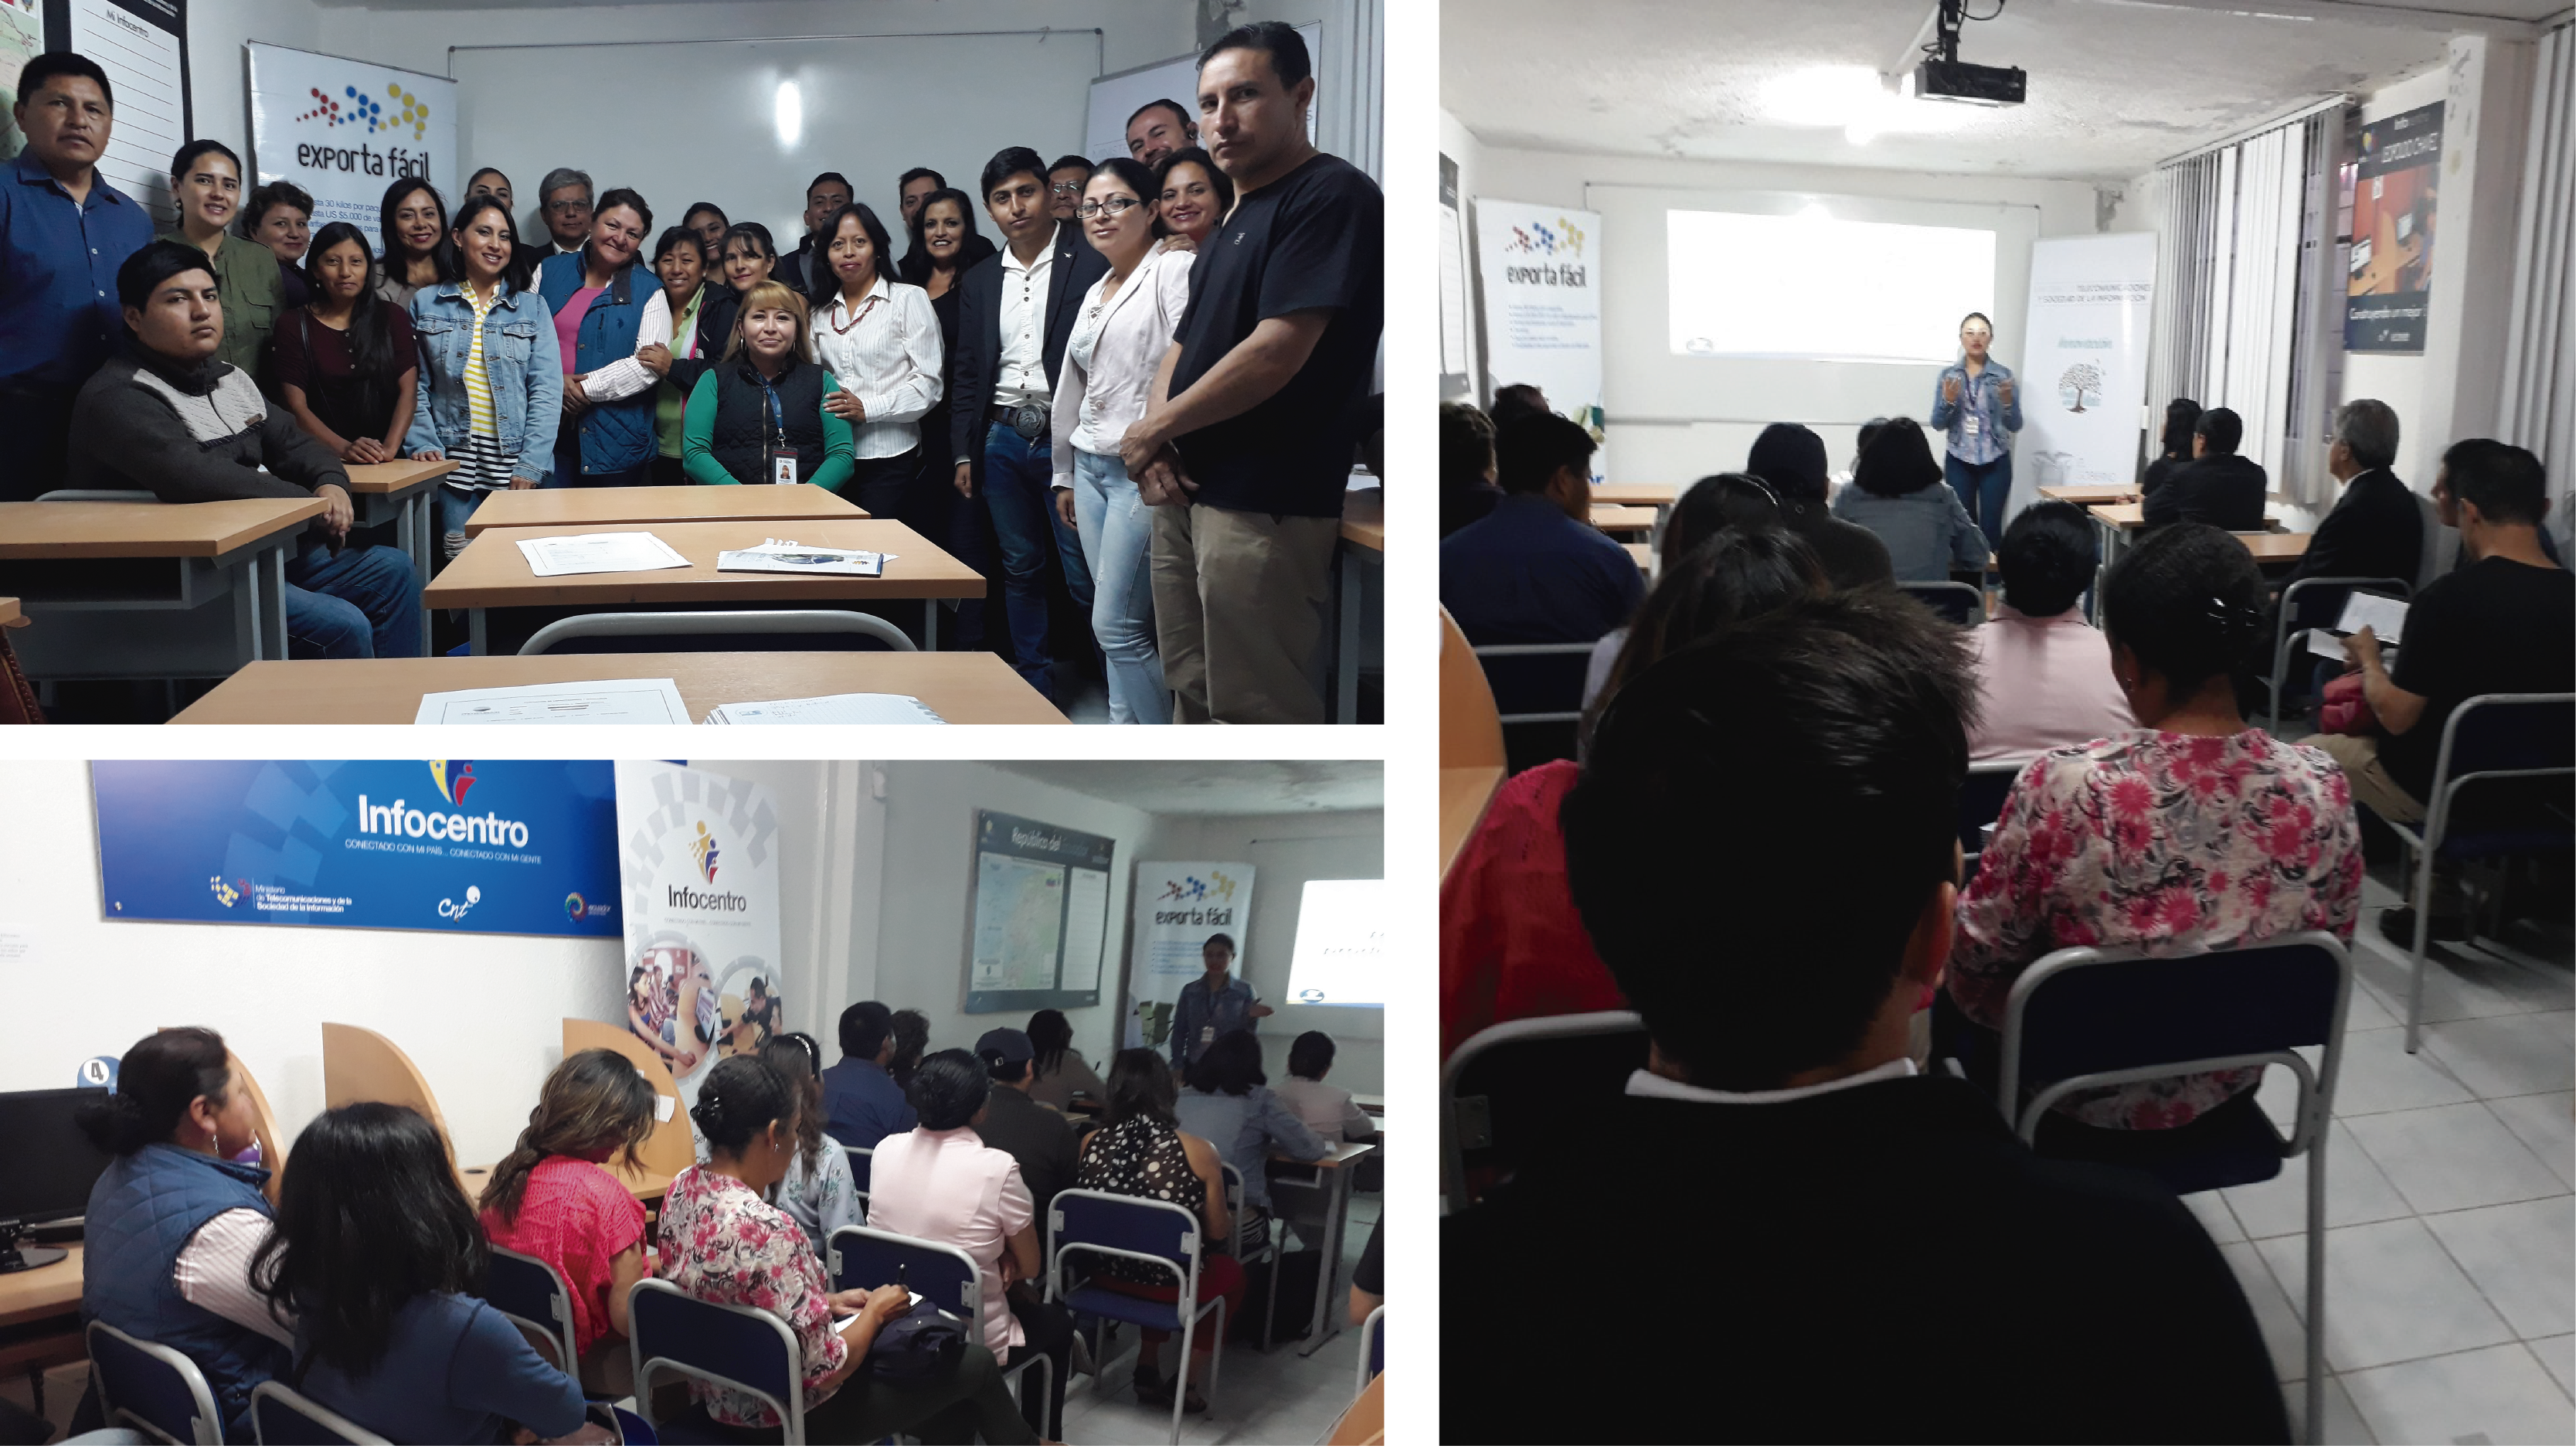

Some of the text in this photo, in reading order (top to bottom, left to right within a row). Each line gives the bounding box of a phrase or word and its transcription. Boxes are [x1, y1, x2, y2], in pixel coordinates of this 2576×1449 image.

[297, 143, 430, 182] exporta fácil
[1507, 261, 1586, 288] exporta fácil
[359, 794, 528, 849] Infocentro
[345, 838, 395, 852] CONECTADO
[396, 842, 414, 854] CON
[416, 845, 425, 854] MI
[450, 848, 494, 861] CONECTADO
[494, 852, 510, 862] CON
[511, 853, 518, 862] MI
[520, 854, 542, 865] GENTE
[1048, 834, 1062, 852] del
[255, 884, 286, 895] Ministerio
[267, 893, 331, 904] Telecomunicaciones
[337, 896, 346, 905] de
[346, 897, 352, 906] la
[668, 883, 746, 913] Infocentro
[257, 902, 345, 913] Sociedad de la Información
[1155, 906, 1232, 926] exporta fácil
[90, 1062, 104, 1081] 4
